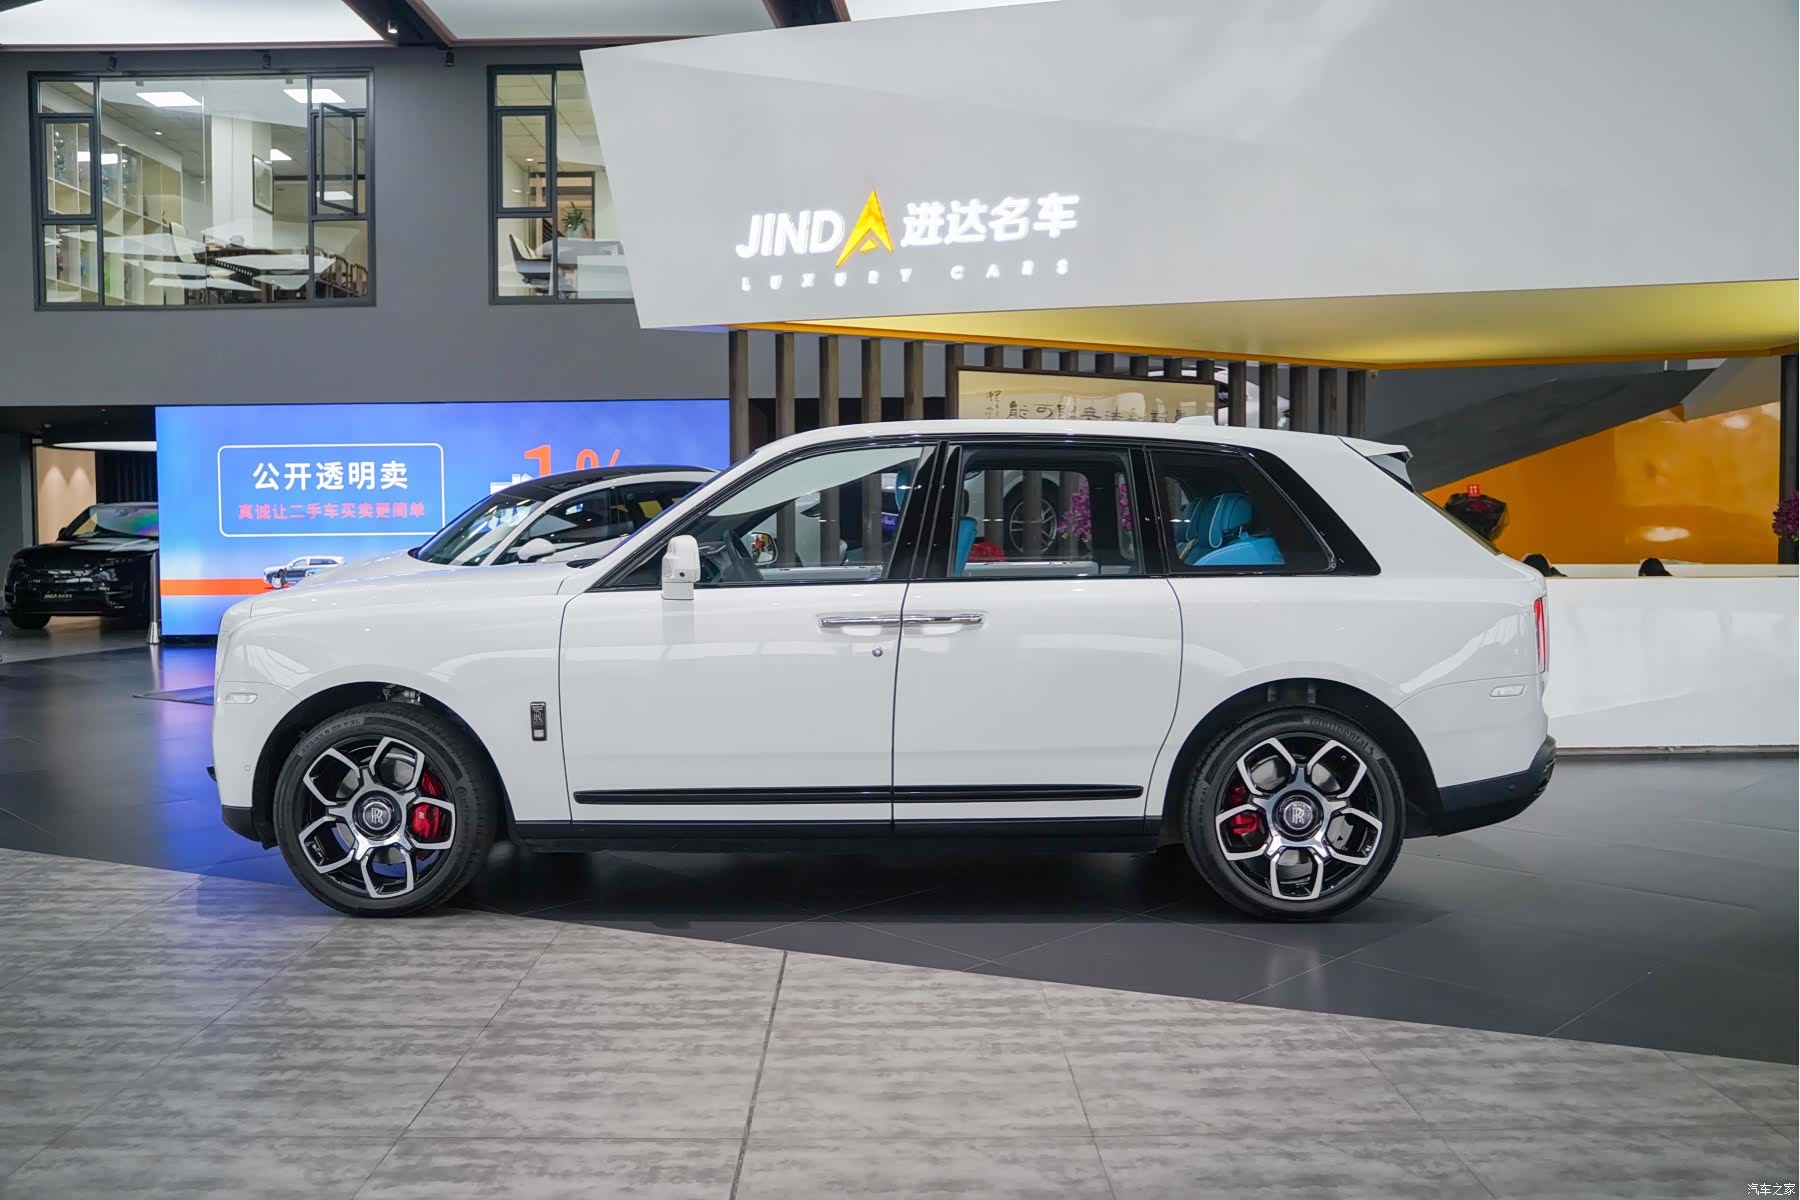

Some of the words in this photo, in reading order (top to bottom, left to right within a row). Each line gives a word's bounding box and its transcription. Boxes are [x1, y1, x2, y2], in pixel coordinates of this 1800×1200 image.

[900, 191, 1080, 247] 进达名车
[741, 268, 912, 292] LUXURY
[950, 257, 1069, 281] CARS
[252, 460, 409, 491] 公开透明卖
[238, 501, 426, 521] 真诚让二手车买卖更简单
